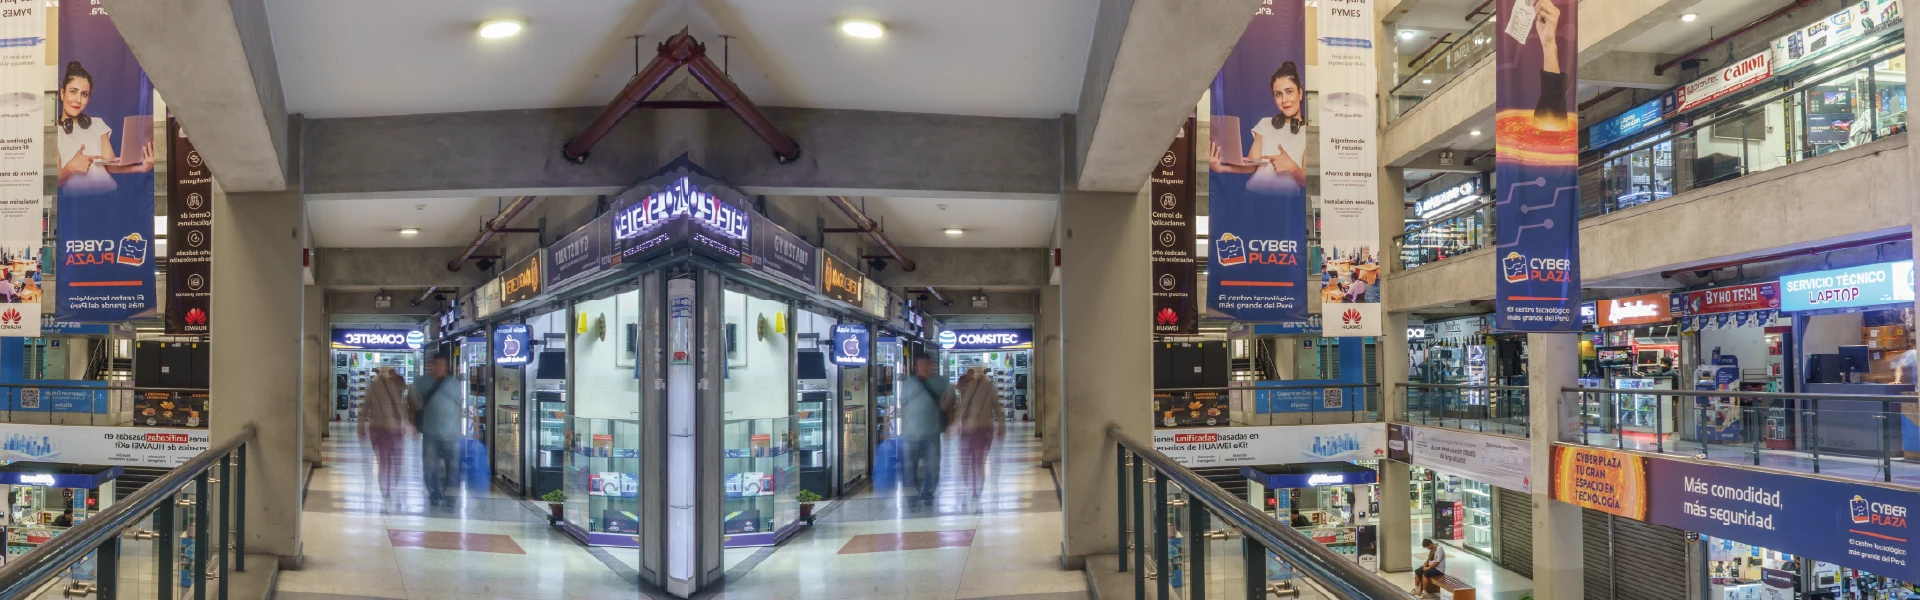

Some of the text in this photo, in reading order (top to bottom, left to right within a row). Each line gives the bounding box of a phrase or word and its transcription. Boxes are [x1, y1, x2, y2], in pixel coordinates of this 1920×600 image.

[1332, 8, 1361, 18] PYMES
[1724, 54, 1765, 81] Canon
[1620, 114, 1635, 124] Laptop
[1620, 118, 1640, 130] Evolution
[774, 234, 808, 266] GYMSTAMP
[1248, 240, 1297, 253] CYBER
[1249, 252, 1297, 265] PLAZA
[1530, 258, 1570, 270] CYBER
[1530, 270, 1571, 282] PLAZA
[1787, 270, 1886, 292] SERVICIO TÉCNICO
[1706, 291, 1730, 305] BYHO
[1732, 287, 1757, 301] TECH
[1809, 287, 1859, 303] LAPTOP
[1536, 307, 1570, 315] tecnológico
[958, 334, 1018, 344] COMSITEC
[1576, 452, 1622, 468] CYBER PLAZA
[1576, 465, 1605, 478] TU GRAN
[1576, 478, 1614, 493] ESPACIO EN
[1576, 490, 1620, 509] TECNOLOGÍA
[1684, 476, 1783, 510] Más comodidad,
[1684, 500, 1775, 530] más seguridad.
[1871, 502, 1907, 517] CYBER
[1871, 514, 1907, 528] PLAZA
[1874, 543, 1906, 555] tecnológico
[1861, 552, 1881, 561] grande
